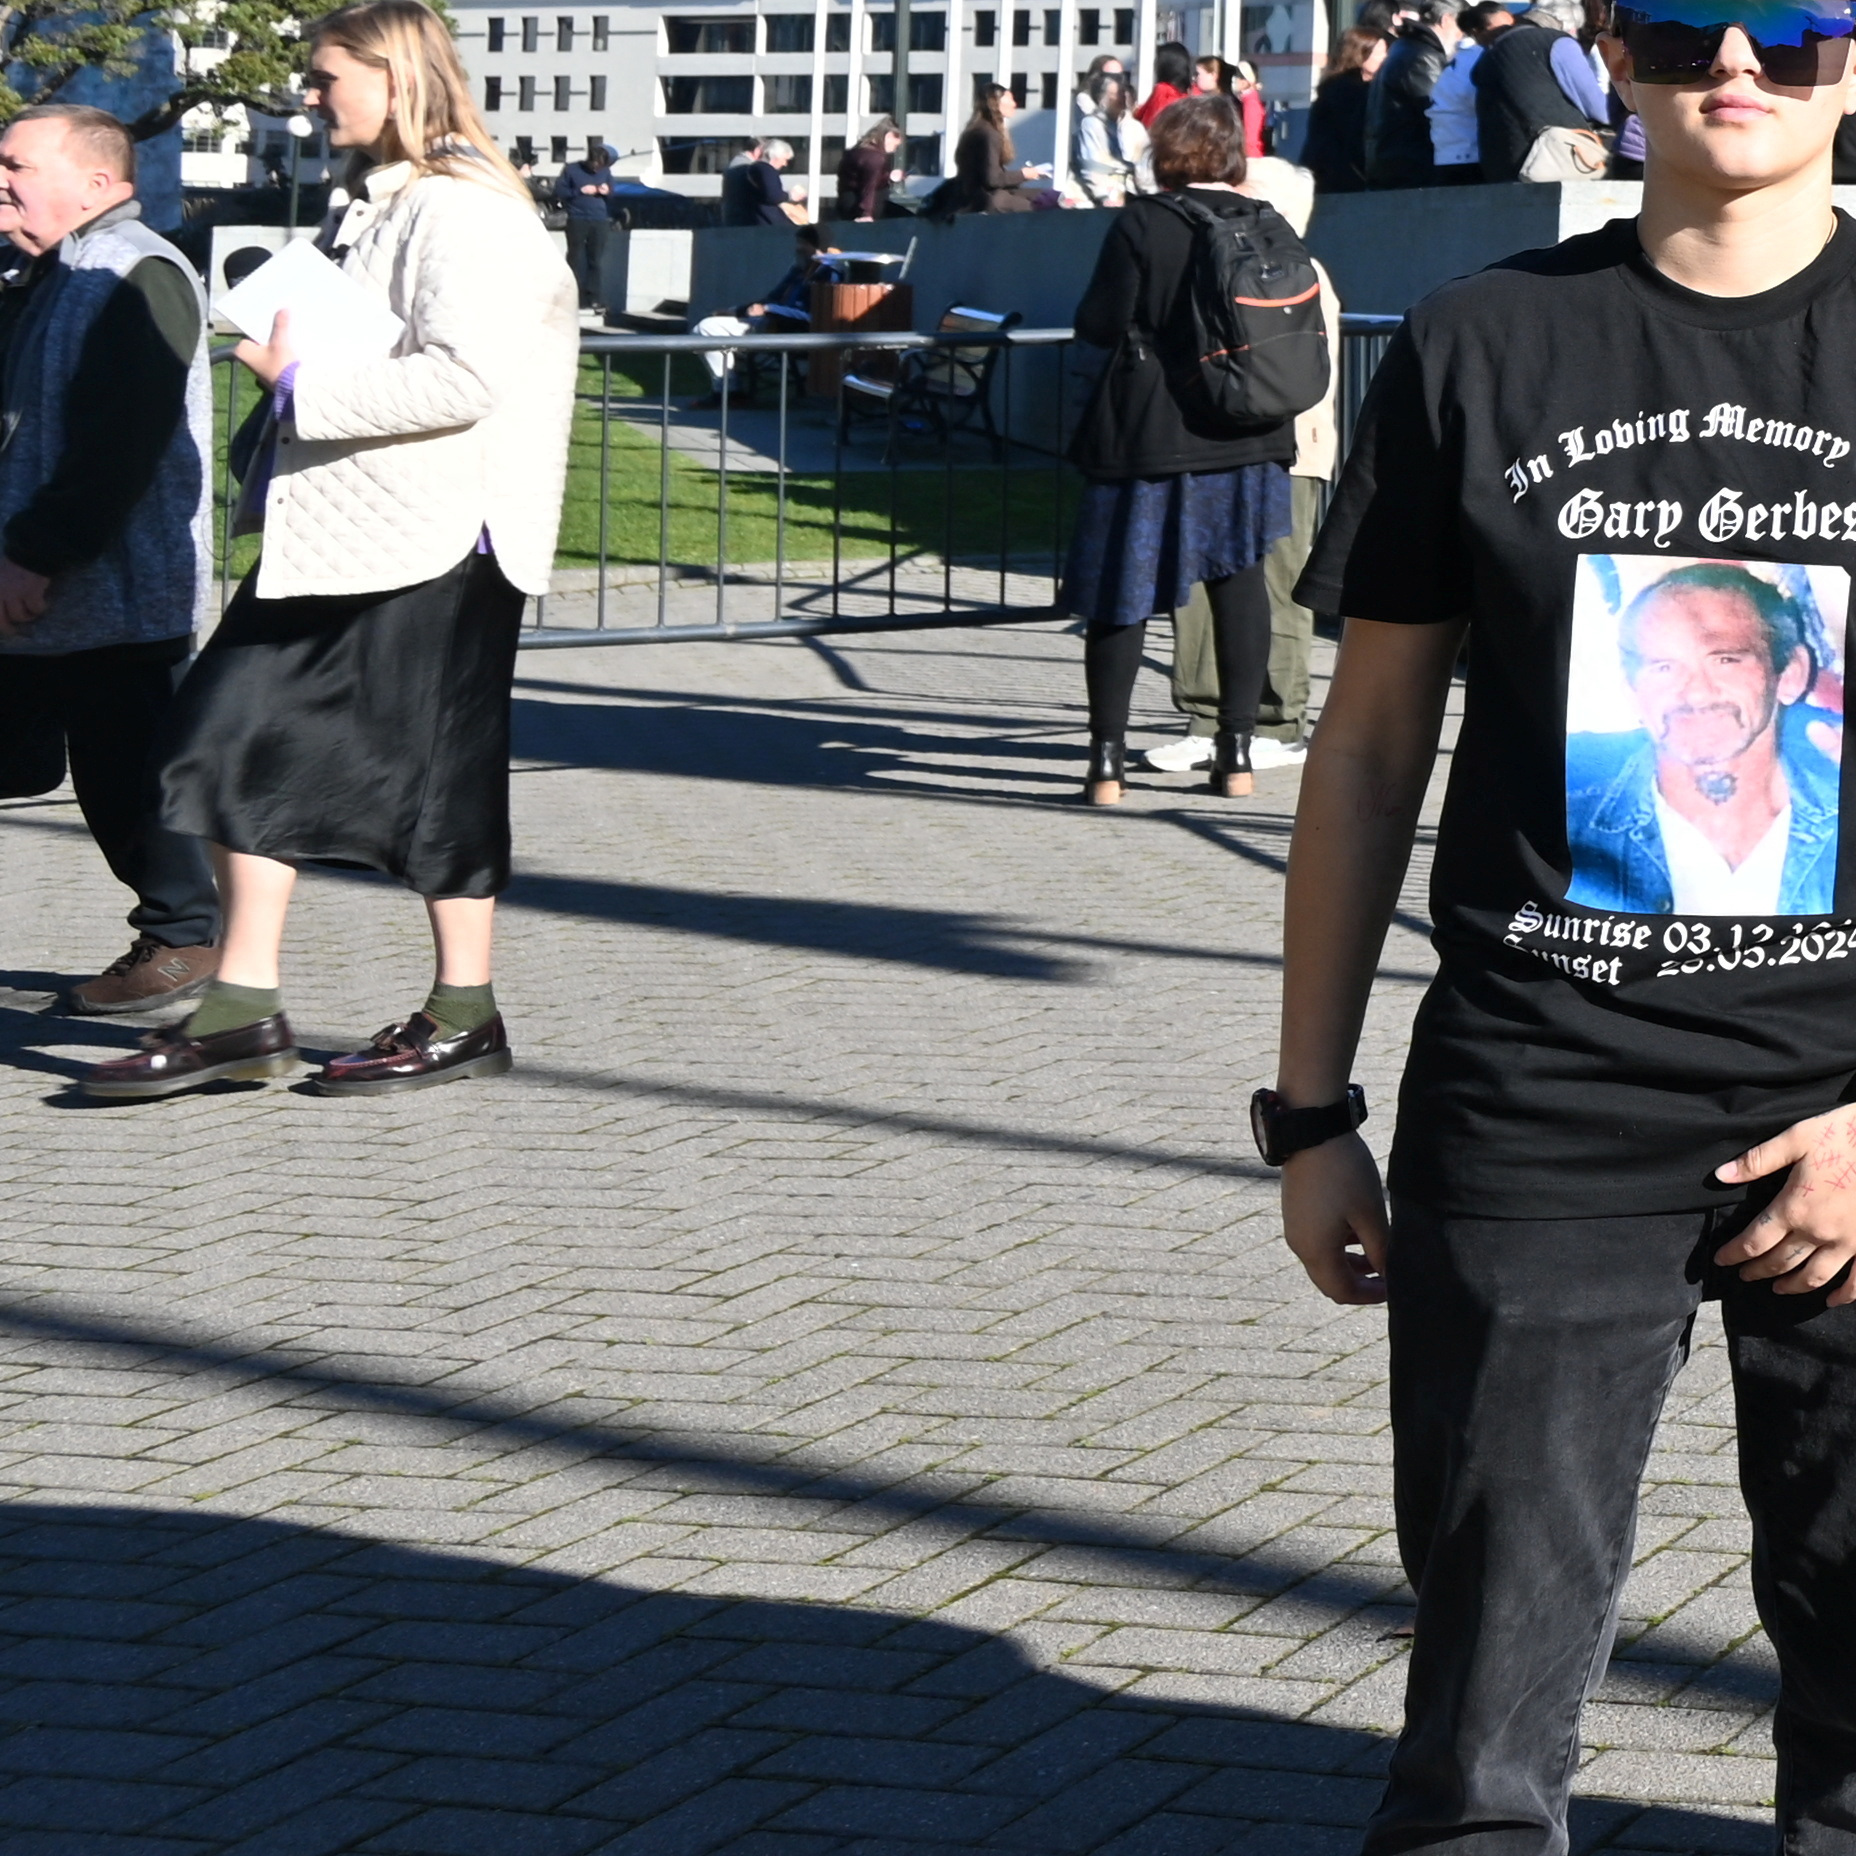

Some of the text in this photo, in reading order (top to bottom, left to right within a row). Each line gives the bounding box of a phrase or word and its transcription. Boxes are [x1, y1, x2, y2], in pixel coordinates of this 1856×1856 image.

[1505, 454, 1554, 504] In
[1558, 409, 1690, 468] Loving
[1700, 402, 1850, 469] Memory
[1557, 487, 1683, 548] Gary
[1508, 900, 1652, 950] Sunrise
